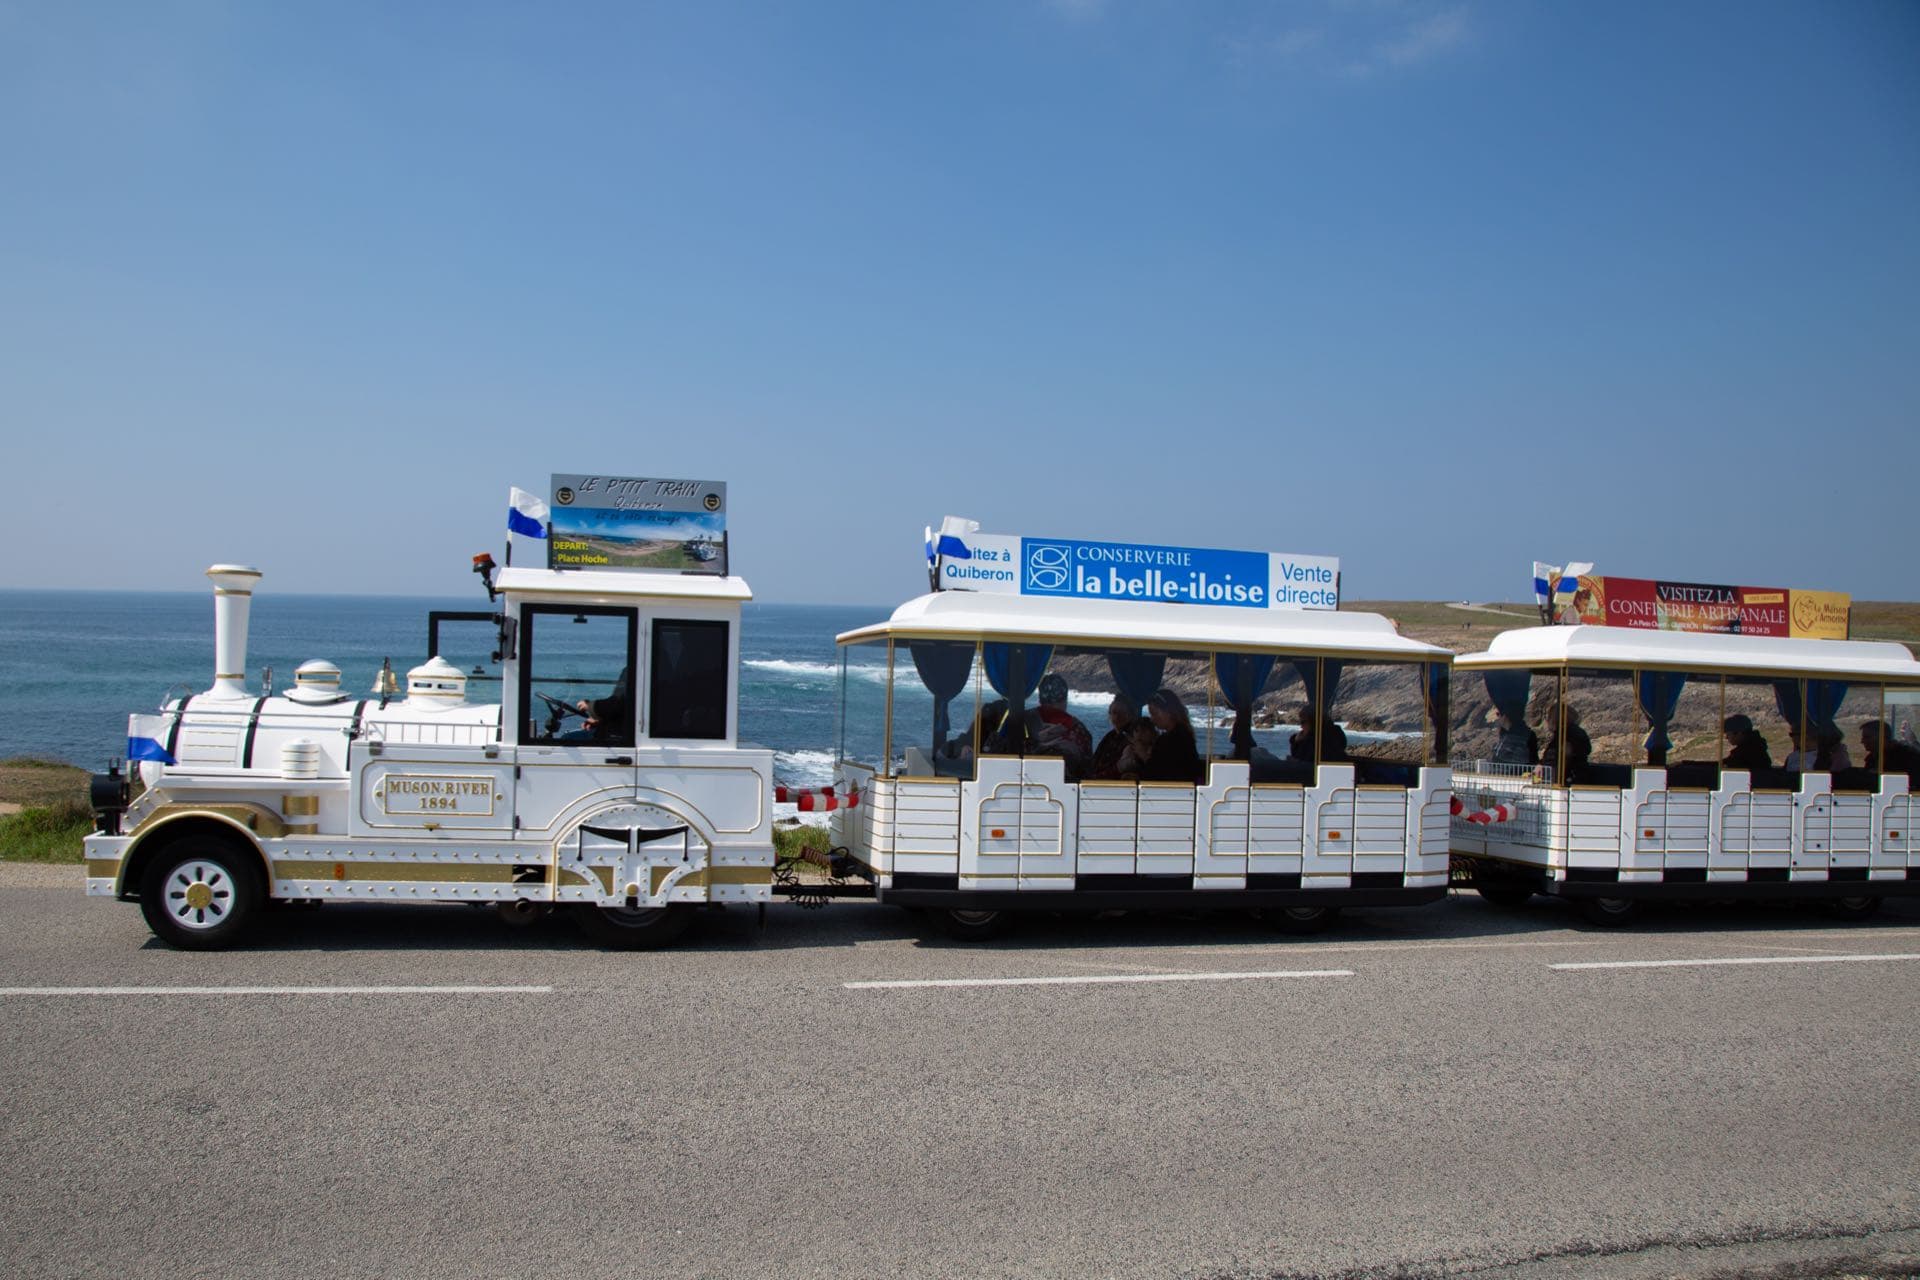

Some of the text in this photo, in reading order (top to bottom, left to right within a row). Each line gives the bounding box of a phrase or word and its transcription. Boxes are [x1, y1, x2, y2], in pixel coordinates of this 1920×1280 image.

[579, 478, 599, 492] LE
[655, 481, 701, 498] TRAIN
[558, 554, 609, 564] Place Hoche
[1002, 549, 1011, 562] à
[1076, 546, 1192, 566] CONSERVERIE
[946, 564, 1014, 581] Quiberon
[1281, 562, 1332, 583] Vente
[1076, 565, 1264, 603] la belle-iloise
[1276, 585, 1336, 606] directe
[1659, 586, 1714, 602] VISITEZ
[1717, 590, 1736, 604] LA
[1610, 600, 1786, 624] CONFISERIE ARTISANALE
[420, 797, 457, 809] 1894
